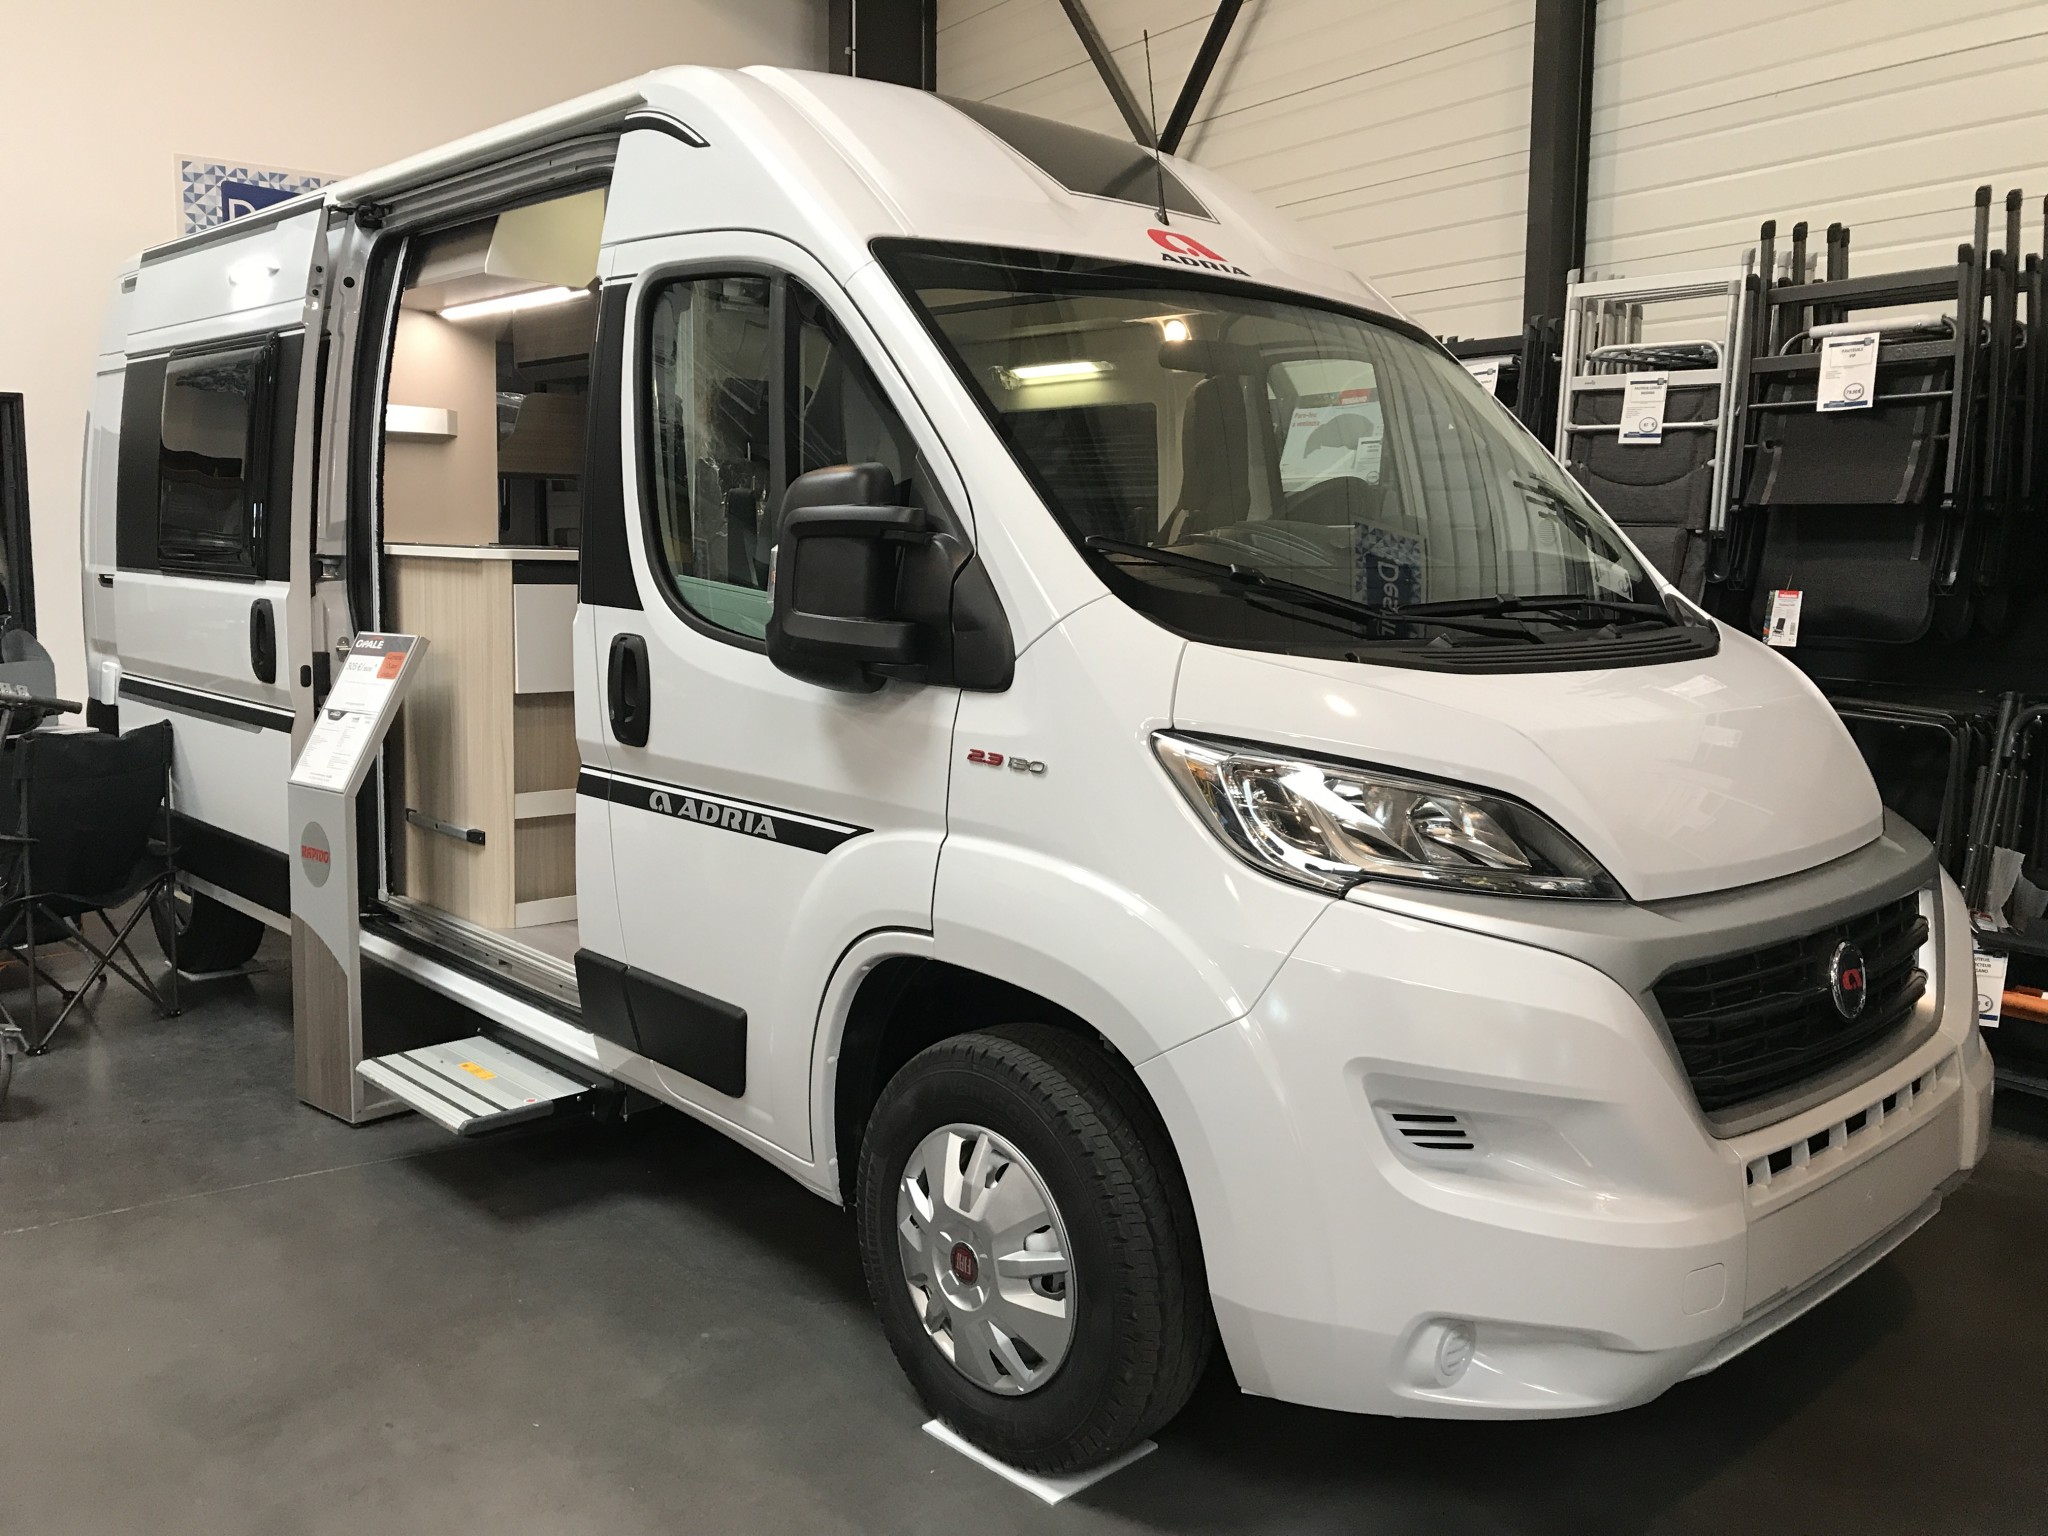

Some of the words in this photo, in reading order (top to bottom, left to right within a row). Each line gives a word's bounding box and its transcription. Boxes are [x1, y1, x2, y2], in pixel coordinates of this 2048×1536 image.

[1161, 252, 1252, 277] ADRIA
[678, 797, 777, 839] ADRIA
[301, 844, 329, 864] RAPIDO
[955, 1252, 972, 1275] FIAT
